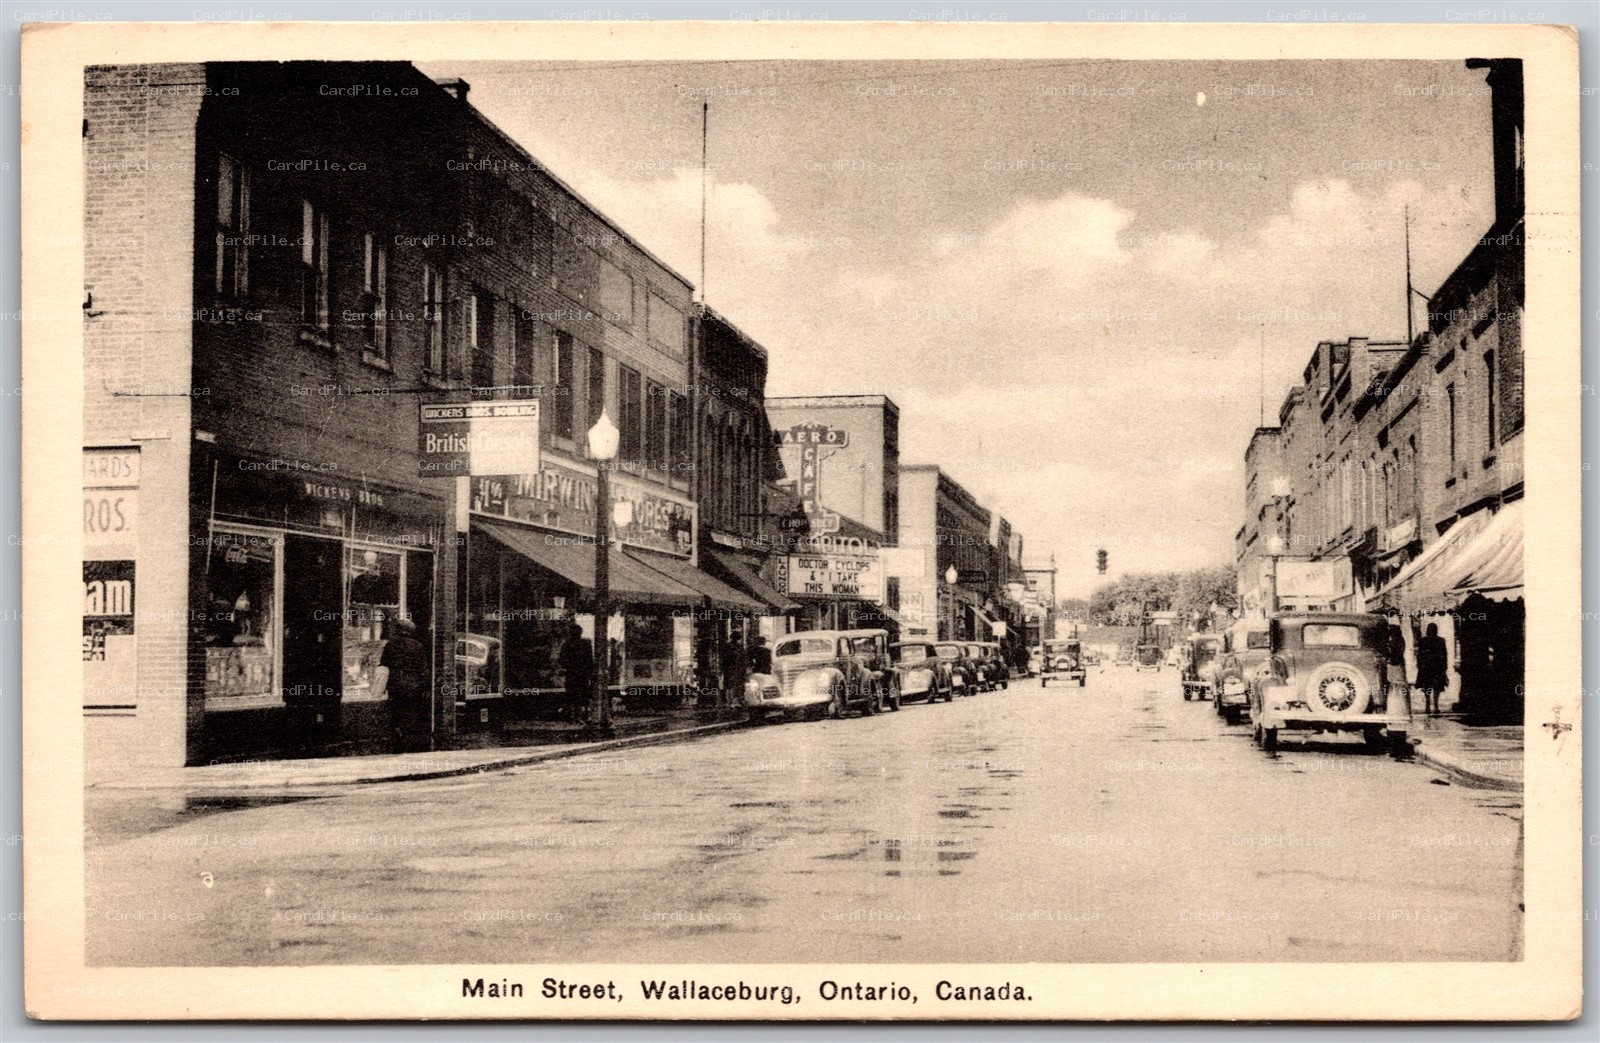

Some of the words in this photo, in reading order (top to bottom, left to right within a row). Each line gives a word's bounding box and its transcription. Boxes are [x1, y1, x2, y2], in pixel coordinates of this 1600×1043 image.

[425, 407, 464, 419] WICKENS
[783, 431, 838, 442] AERO
[803, 448, 815, 513] CAFE
[798, 558, 829, 570] DOCTOR
[835, 560, 871, 572] CYCLOPS
[837, 572, 859, 583] TAKE
[805, 582, 823, 593] THIS
